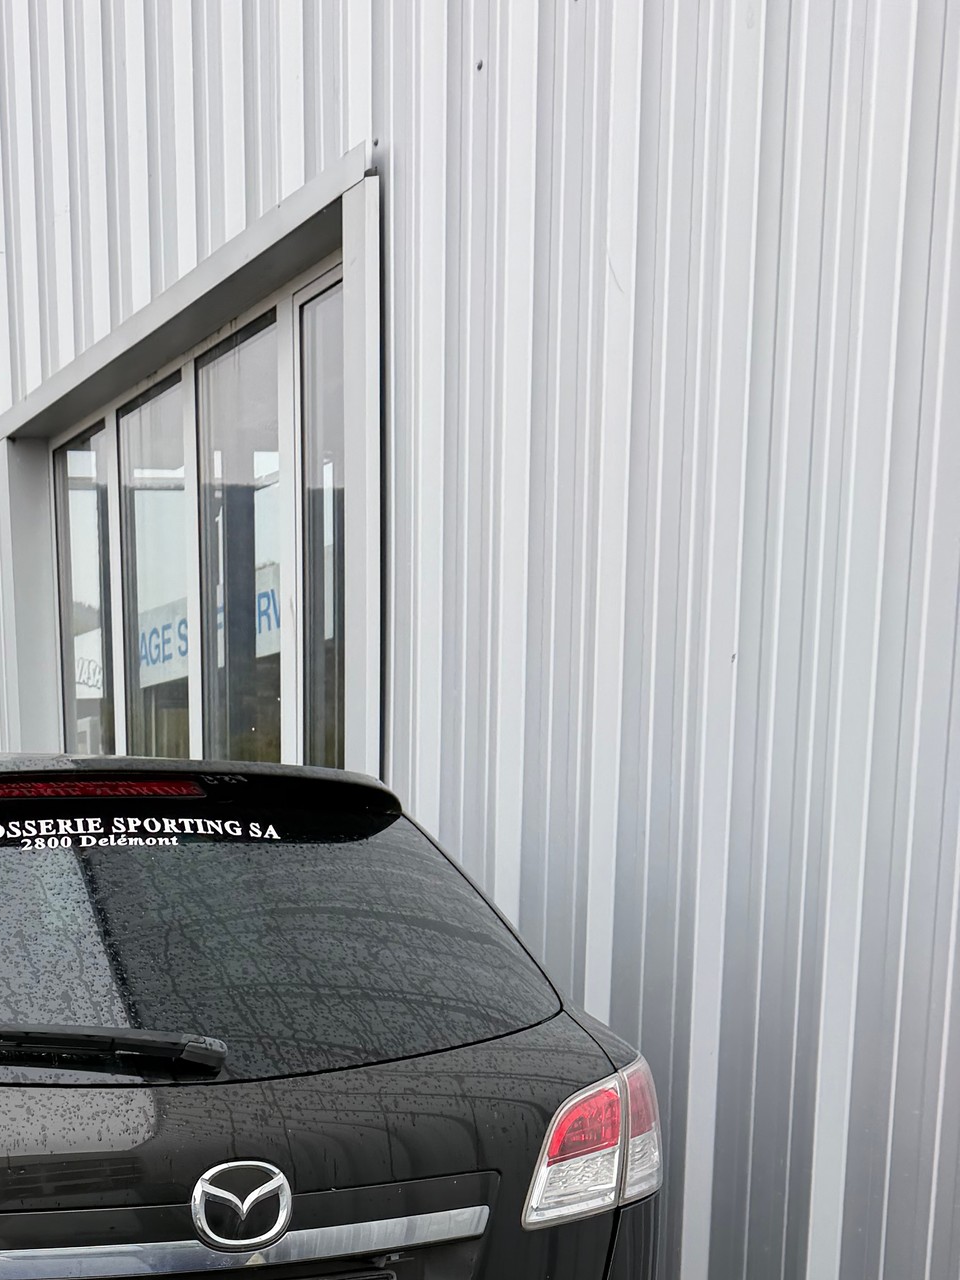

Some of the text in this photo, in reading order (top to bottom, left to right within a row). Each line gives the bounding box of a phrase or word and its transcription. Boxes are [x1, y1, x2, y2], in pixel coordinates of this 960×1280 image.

[111, 817, 242, 836] SPORTING
[249, 822, 281, 839] SA
[20, 834, 179, 851] 2800 Delémont
